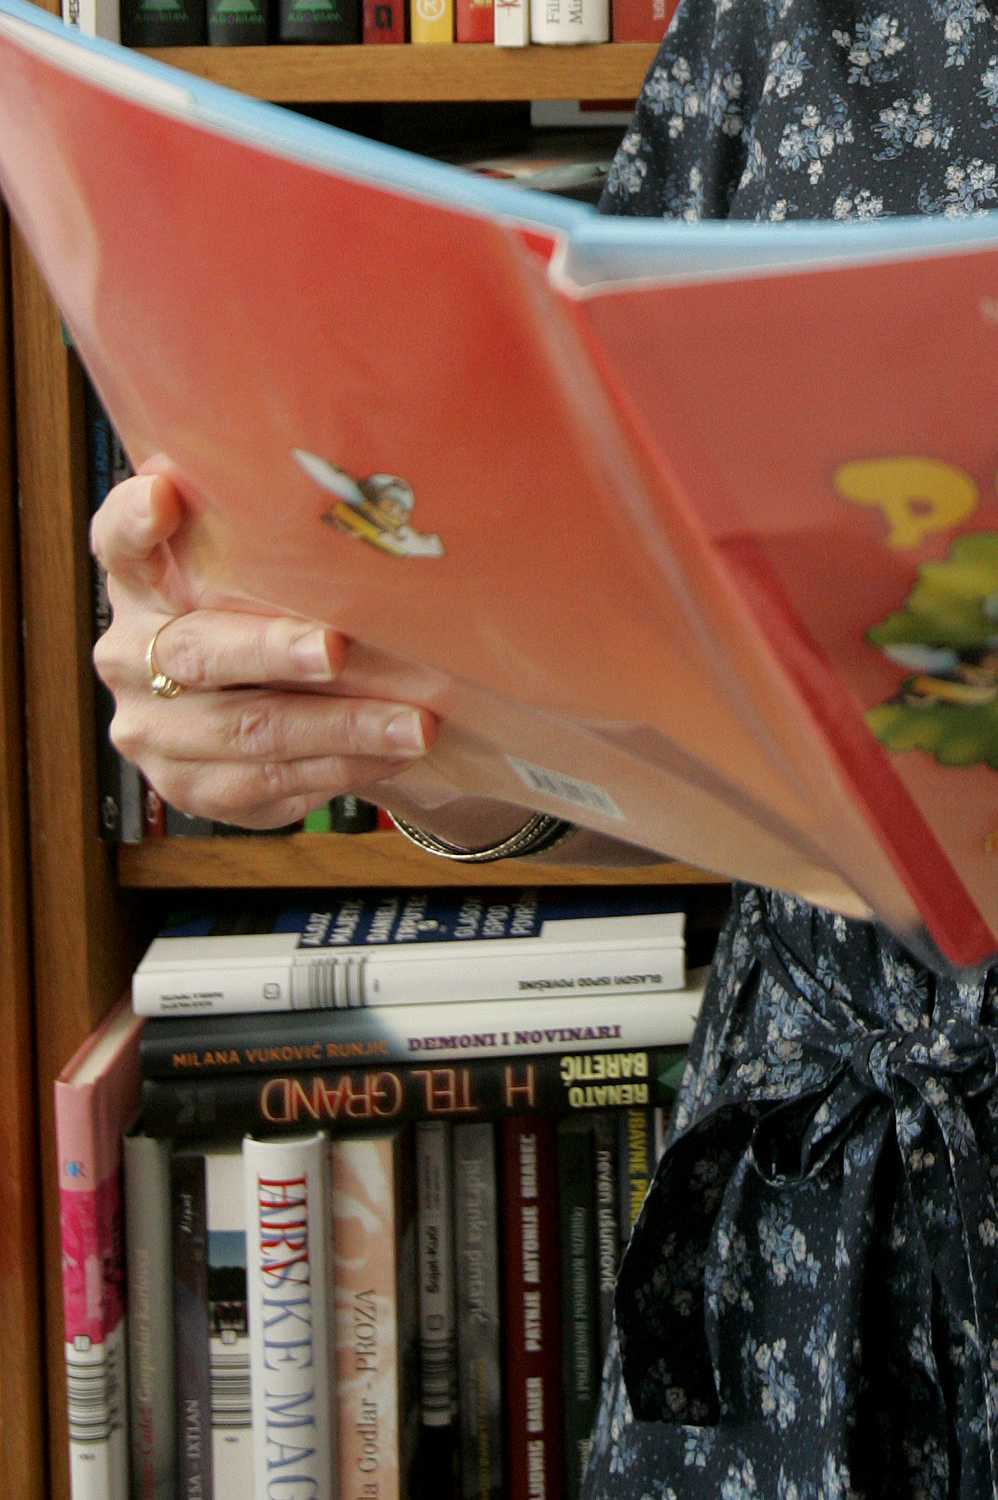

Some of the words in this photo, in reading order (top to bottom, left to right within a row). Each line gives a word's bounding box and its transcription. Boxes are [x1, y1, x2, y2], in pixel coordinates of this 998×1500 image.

[172, 1049, 241, 1068] MILANA
[245, 1042, 324, 1063] VUKOVIĆ
[325, 1038, 390, 1059] RUNJIĆ
[407, 1031, 497, 1053] DEMONI
[501, 1032, 512, 1047] I
[515, 1024, 623, 1046] NOVINARI
[560, 1052, 649, 1083] BARETIĆ
[568, 1084, 650, 1108] RENATO
[260, 1071, 402, 1124] GRAND
[519, 1134, 538, 1199] BRABEC
[596, 1150, 616, 1204] neven
[521, 1205, 540, 1284] ANTONIJE
[597, 1208, 619, 1293] ušumović
[354, 1288, 377, 1372] PROZA
[522, 1290, 542, 1352] PATNJE
[525, 1377, 544, 1434] BAUER
[356, 1397, 378, 1473] Godlar
